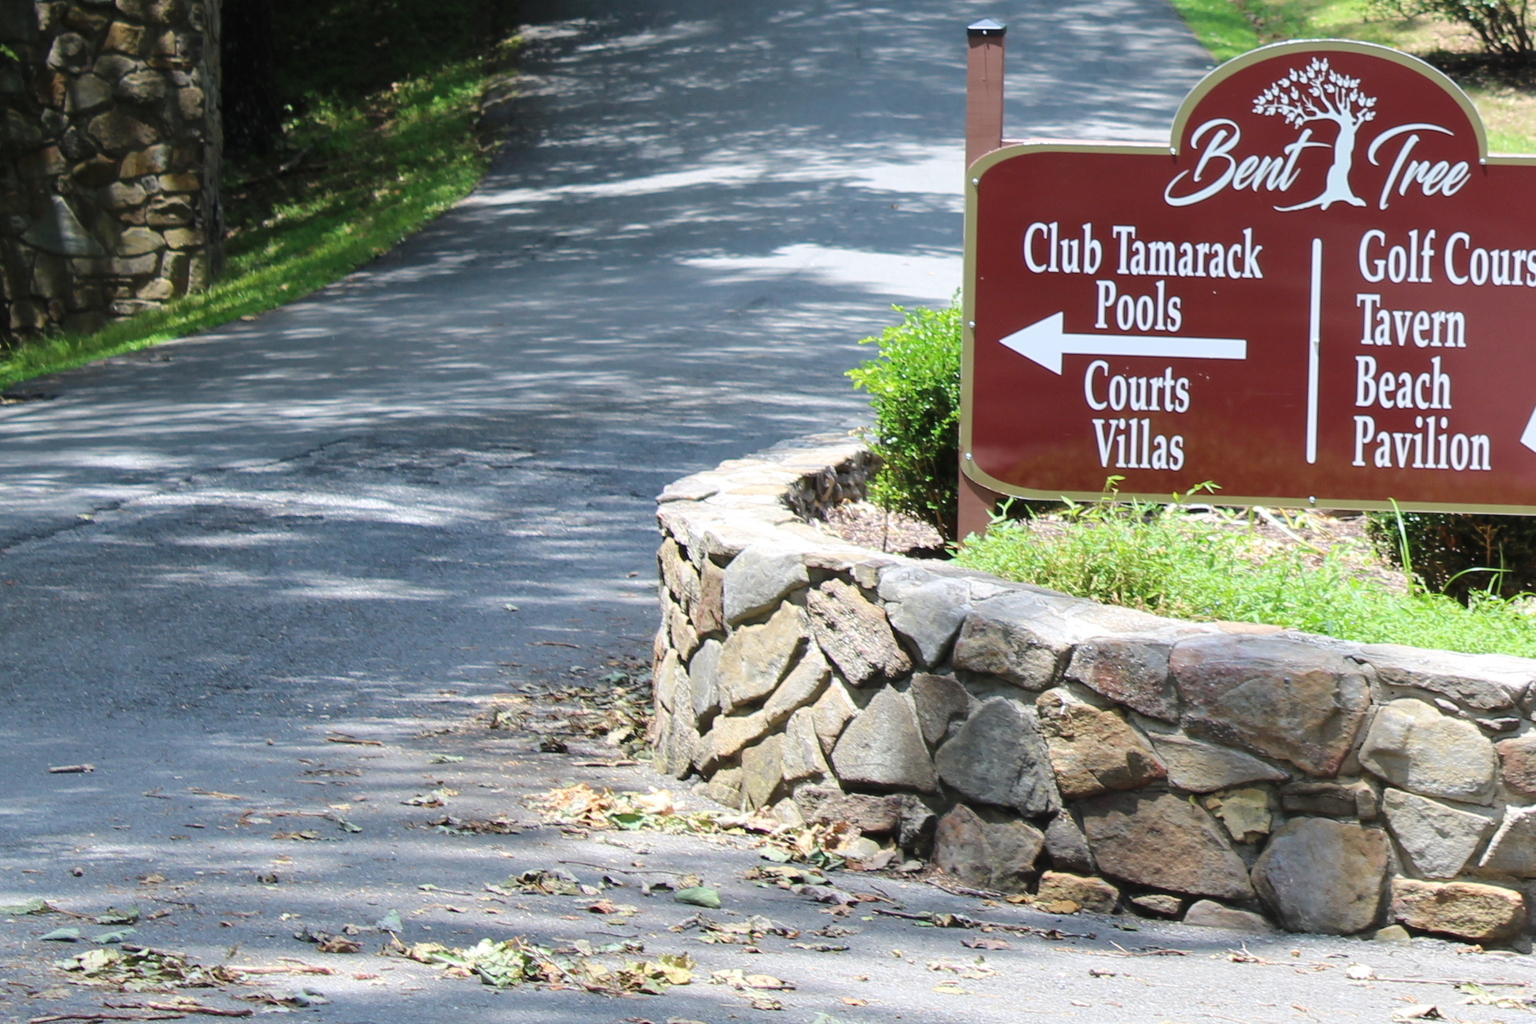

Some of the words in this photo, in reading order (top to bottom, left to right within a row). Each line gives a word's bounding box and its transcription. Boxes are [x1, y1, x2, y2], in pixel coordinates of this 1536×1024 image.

[1164, 118, 1332, 207] Bent
[1367, 123, 1471, 211] Tree
[1023, 221, 1103, 275] Club
[1112, 225, 1264, 279] Tamarack
[1358, 229, 1436, 284] Golf
[1094, 280, 1182, 332] Pools
[1356, 293, 1467, 348] Tavern
[1084, 360, 1190, 413] Courts
[1355, 355, 1452, 410] Beach
[1091, 418, 1185, 471] Villas
[1351, 415, 1492, 471] Pavilion
